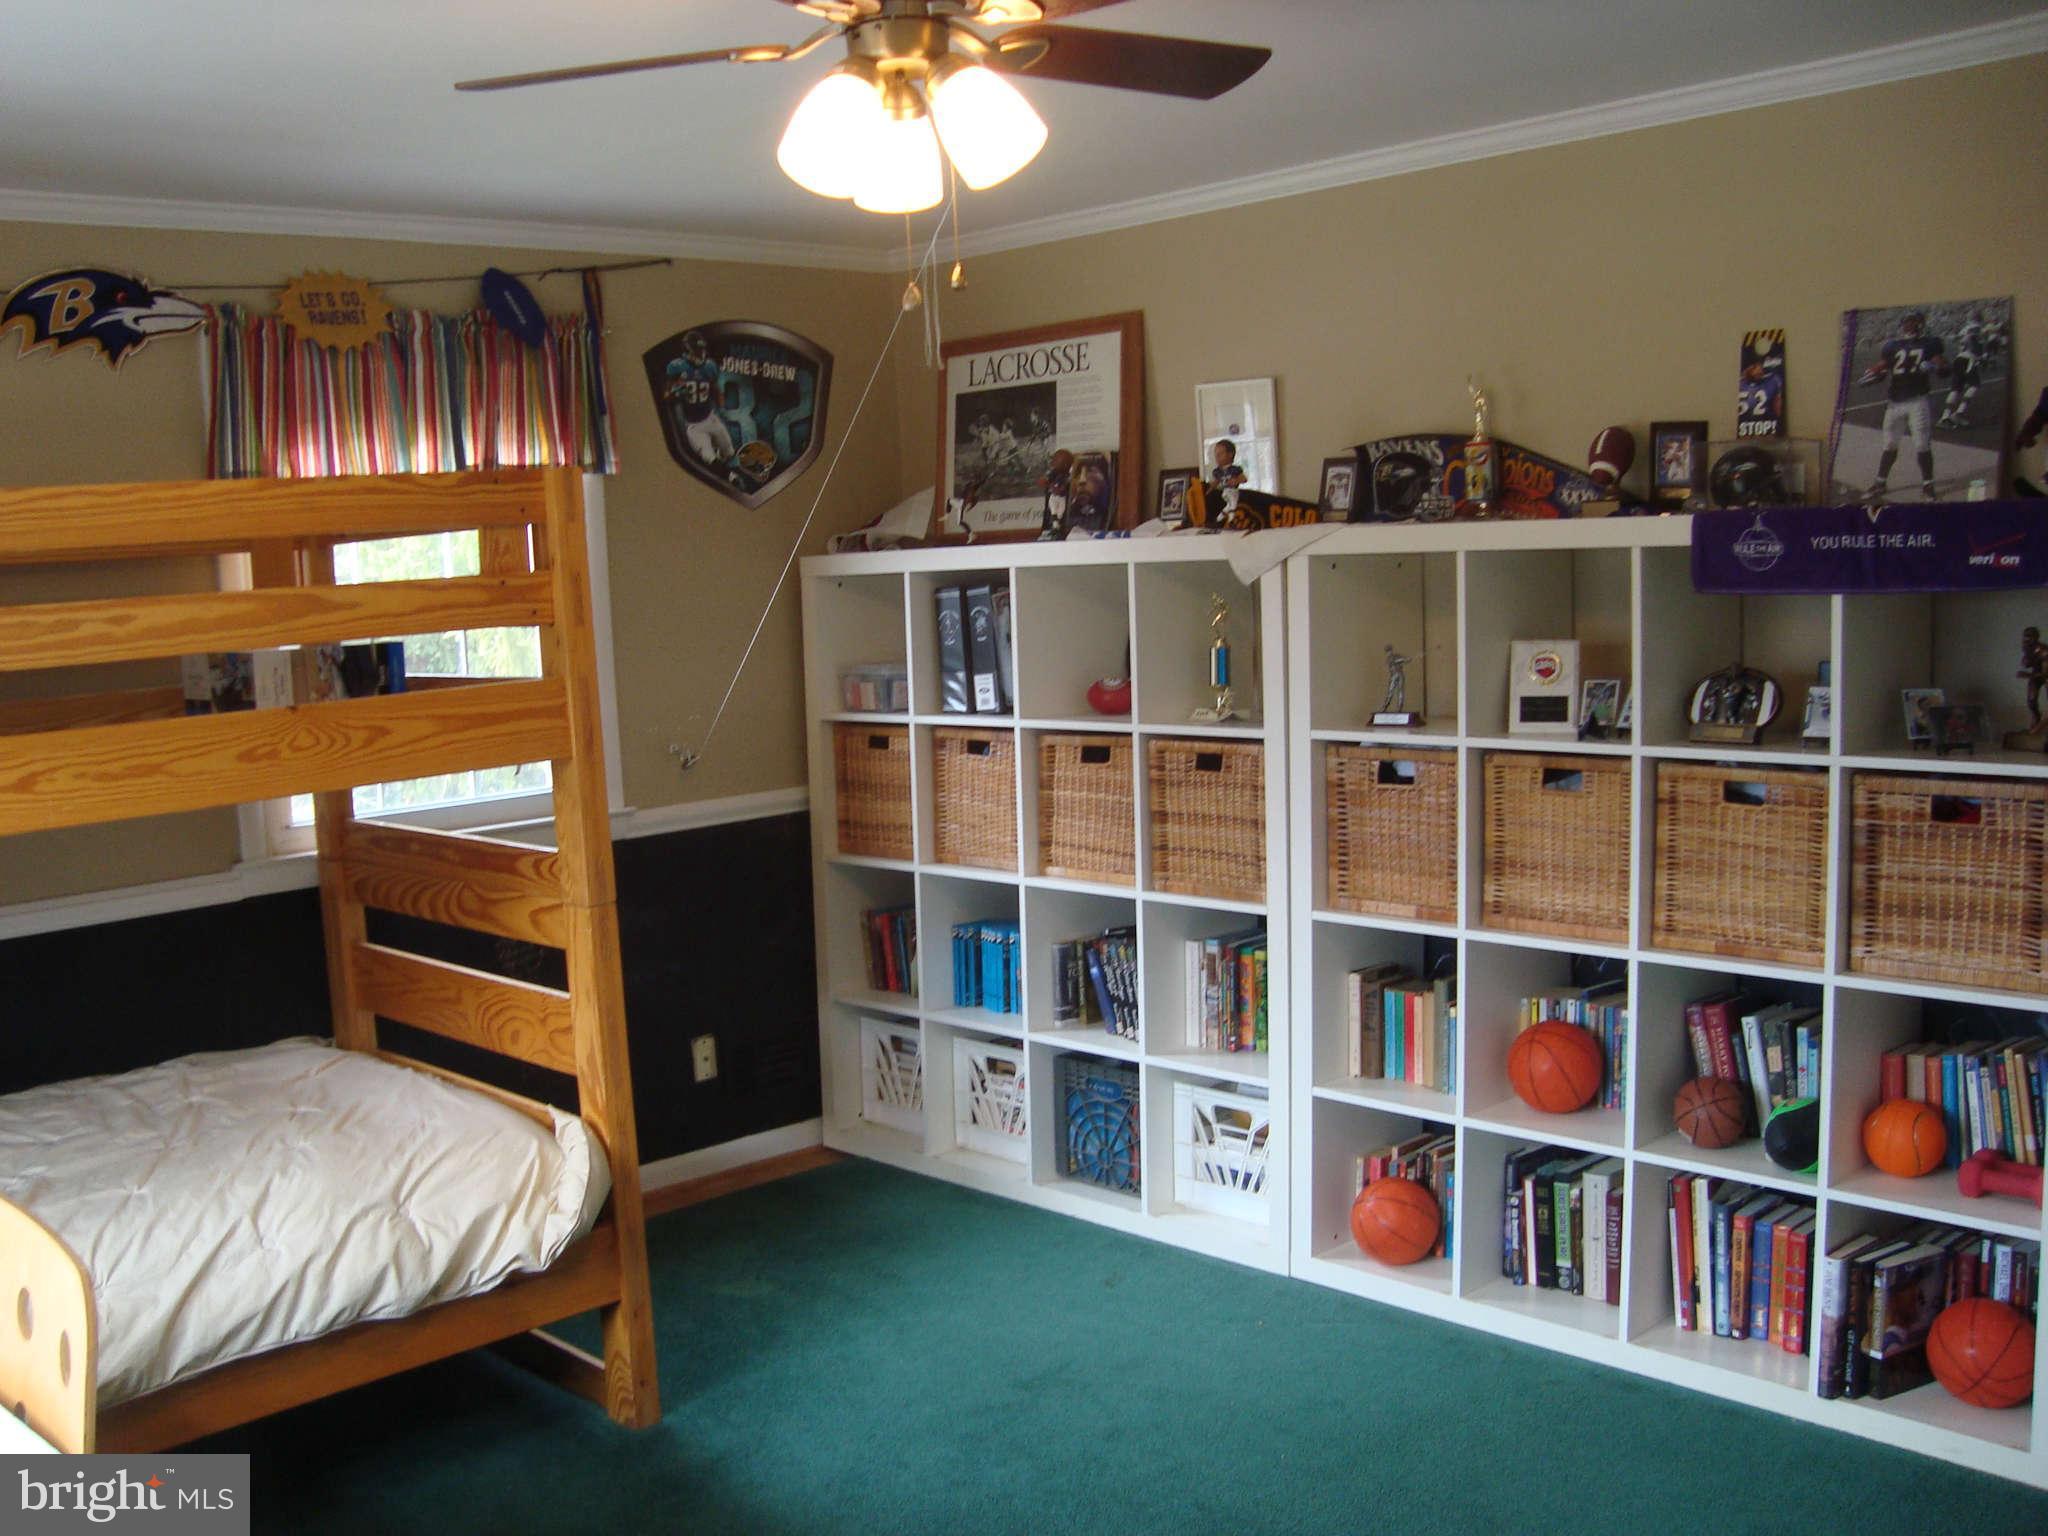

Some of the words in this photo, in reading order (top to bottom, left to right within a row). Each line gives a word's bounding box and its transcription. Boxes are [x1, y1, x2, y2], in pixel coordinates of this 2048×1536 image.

[307, 308, 367, 326] RAVENS!
[720, 357, 797, 382] JONES-DREW
[967, 341, 1091, 388] LACROSSE
[1892, 348, 1925, 375] 27
[1737, 389, 1768, 415] 52
[1738, 420, 1778, 437] STOP!
[1366, 439, 1444, 466] RAVENS
[983, 510, 998, 523] The
[998, 509, 1022, 525] game
[1022, 506, 1033, 524] of
[1810, 536, 1840, 550] YOU
[1841, 535, 1876, 549] RULE
[1878, 534, 1904, 548] THE
[1906, 533, 1936, 548] AIR.
[1968, 551, 2021, 568] verizon
